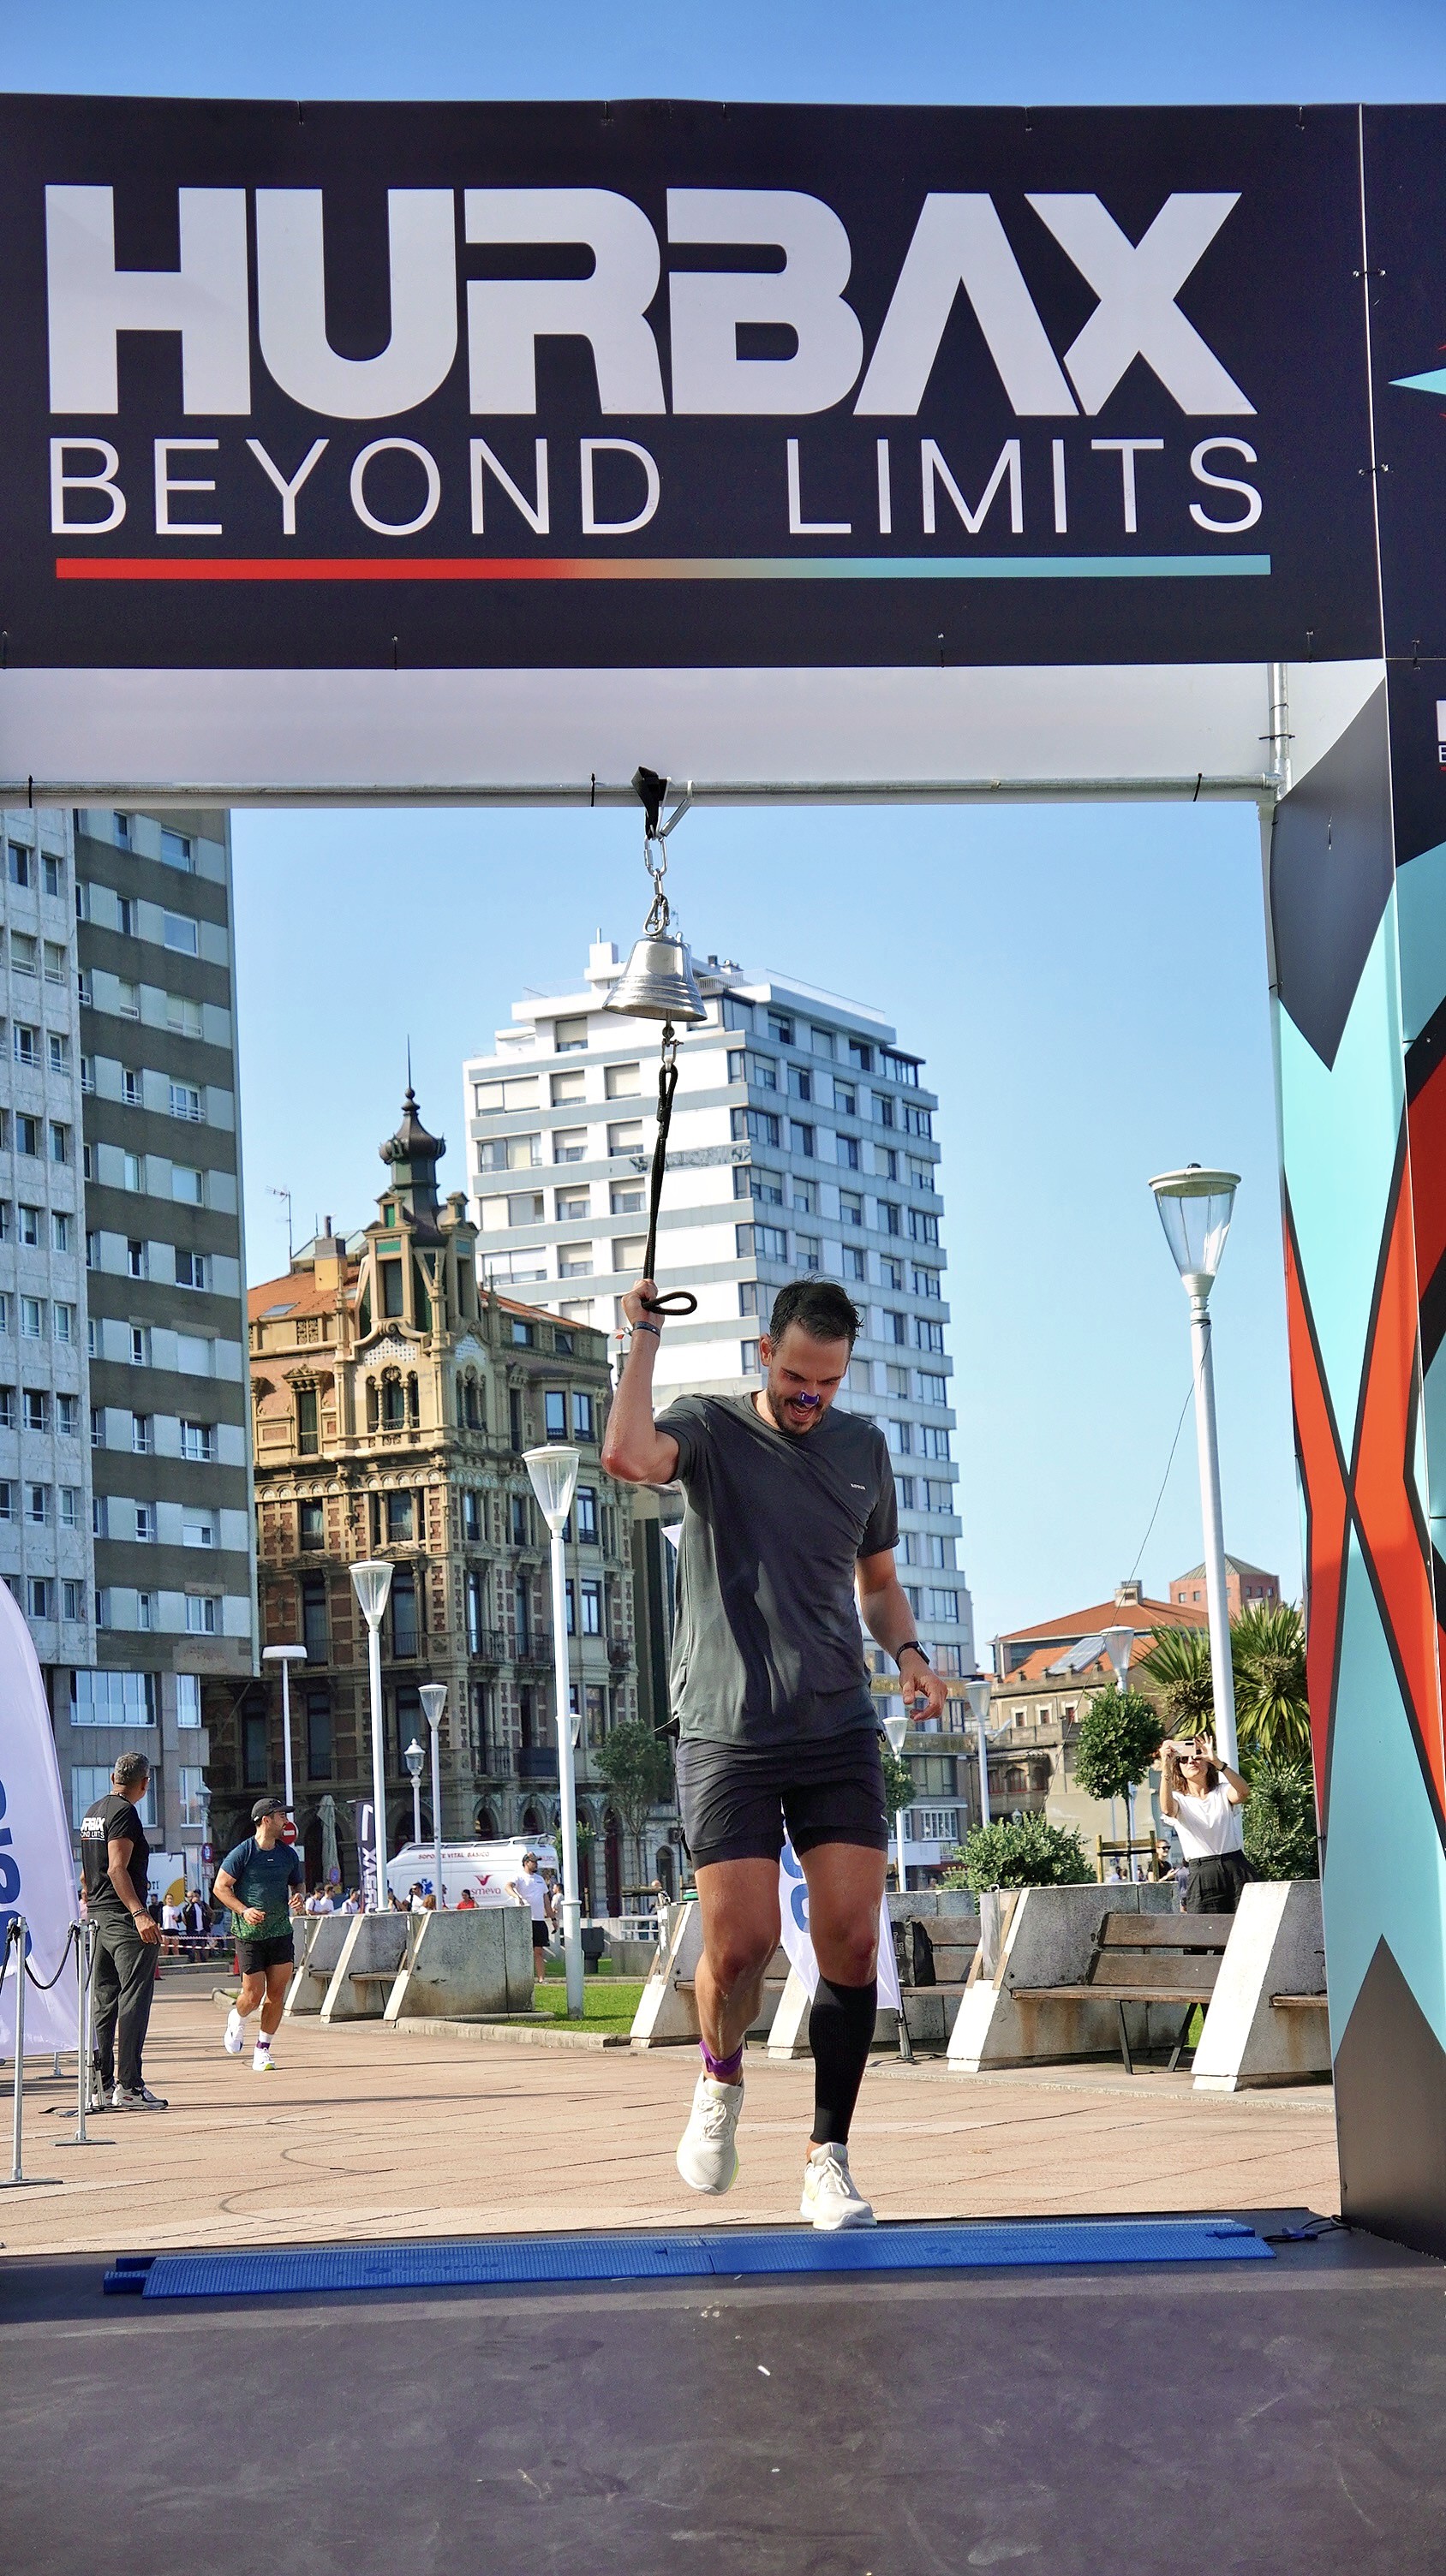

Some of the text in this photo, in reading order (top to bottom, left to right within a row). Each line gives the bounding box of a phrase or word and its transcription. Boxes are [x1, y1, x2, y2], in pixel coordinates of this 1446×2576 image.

[45, 184, 1258, 419] HURBAX
[50, 436, 1263, 535] BEYOND LIMITS
